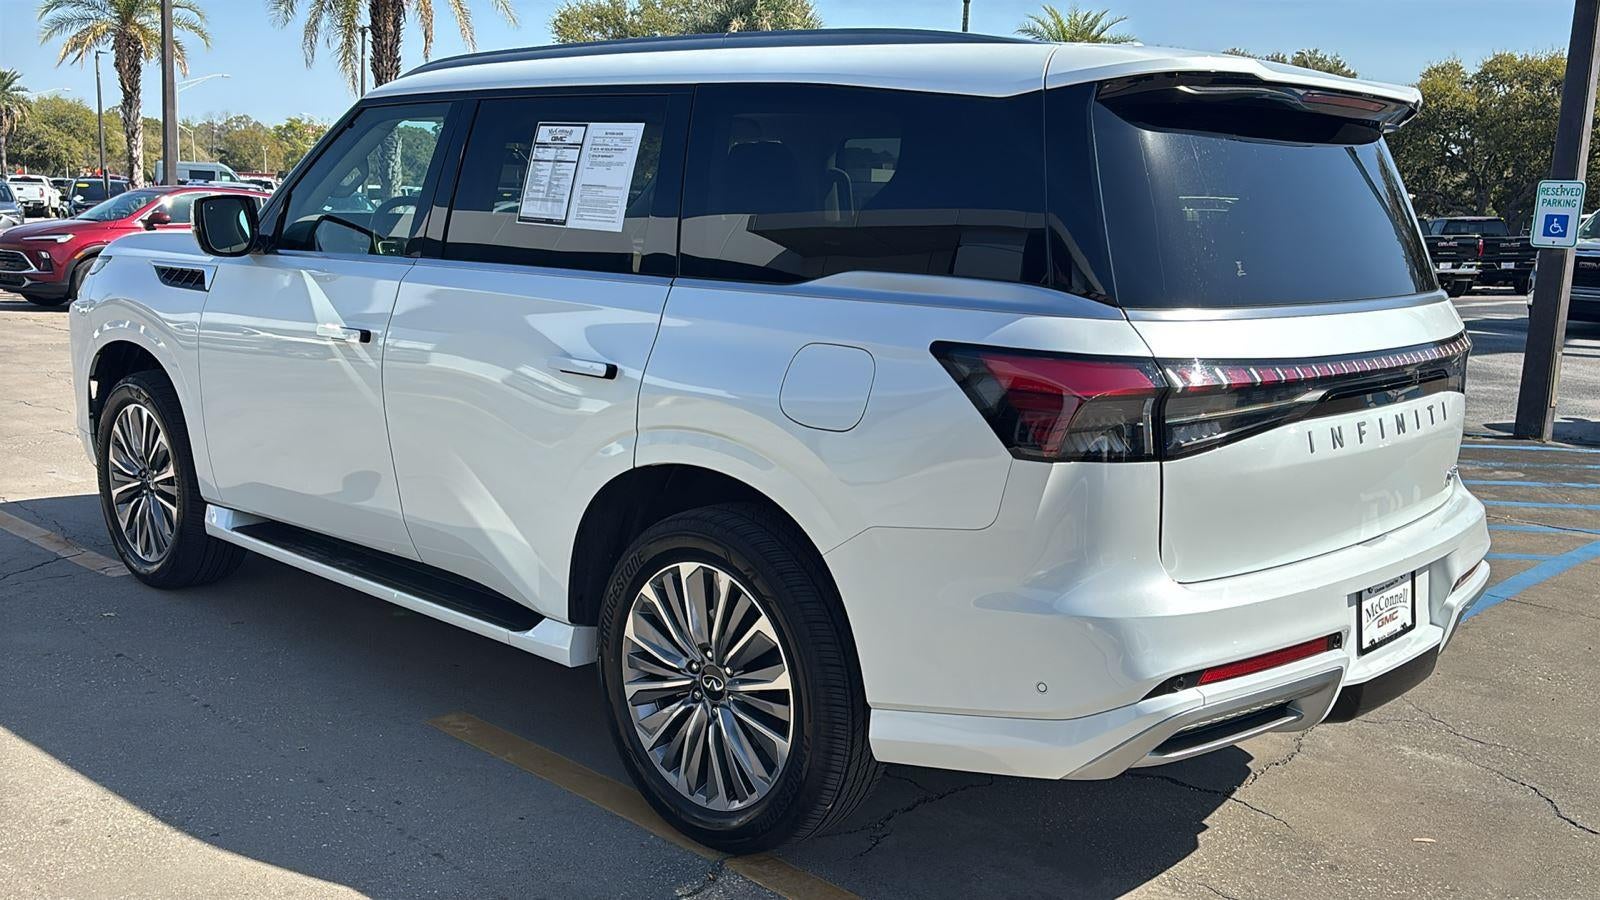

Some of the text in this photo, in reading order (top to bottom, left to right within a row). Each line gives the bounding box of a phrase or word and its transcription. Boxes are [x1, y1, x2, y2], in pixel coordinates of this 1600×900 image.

[1541, 187, 1581, 197] RESERVED
[1541, 199, 1577, 208] PARKING
[1307, 401, 1447, 454] INFINITI
[1365, 588, 1408, 623] McConnell
[1377, 610, 1399, 629] GMC
